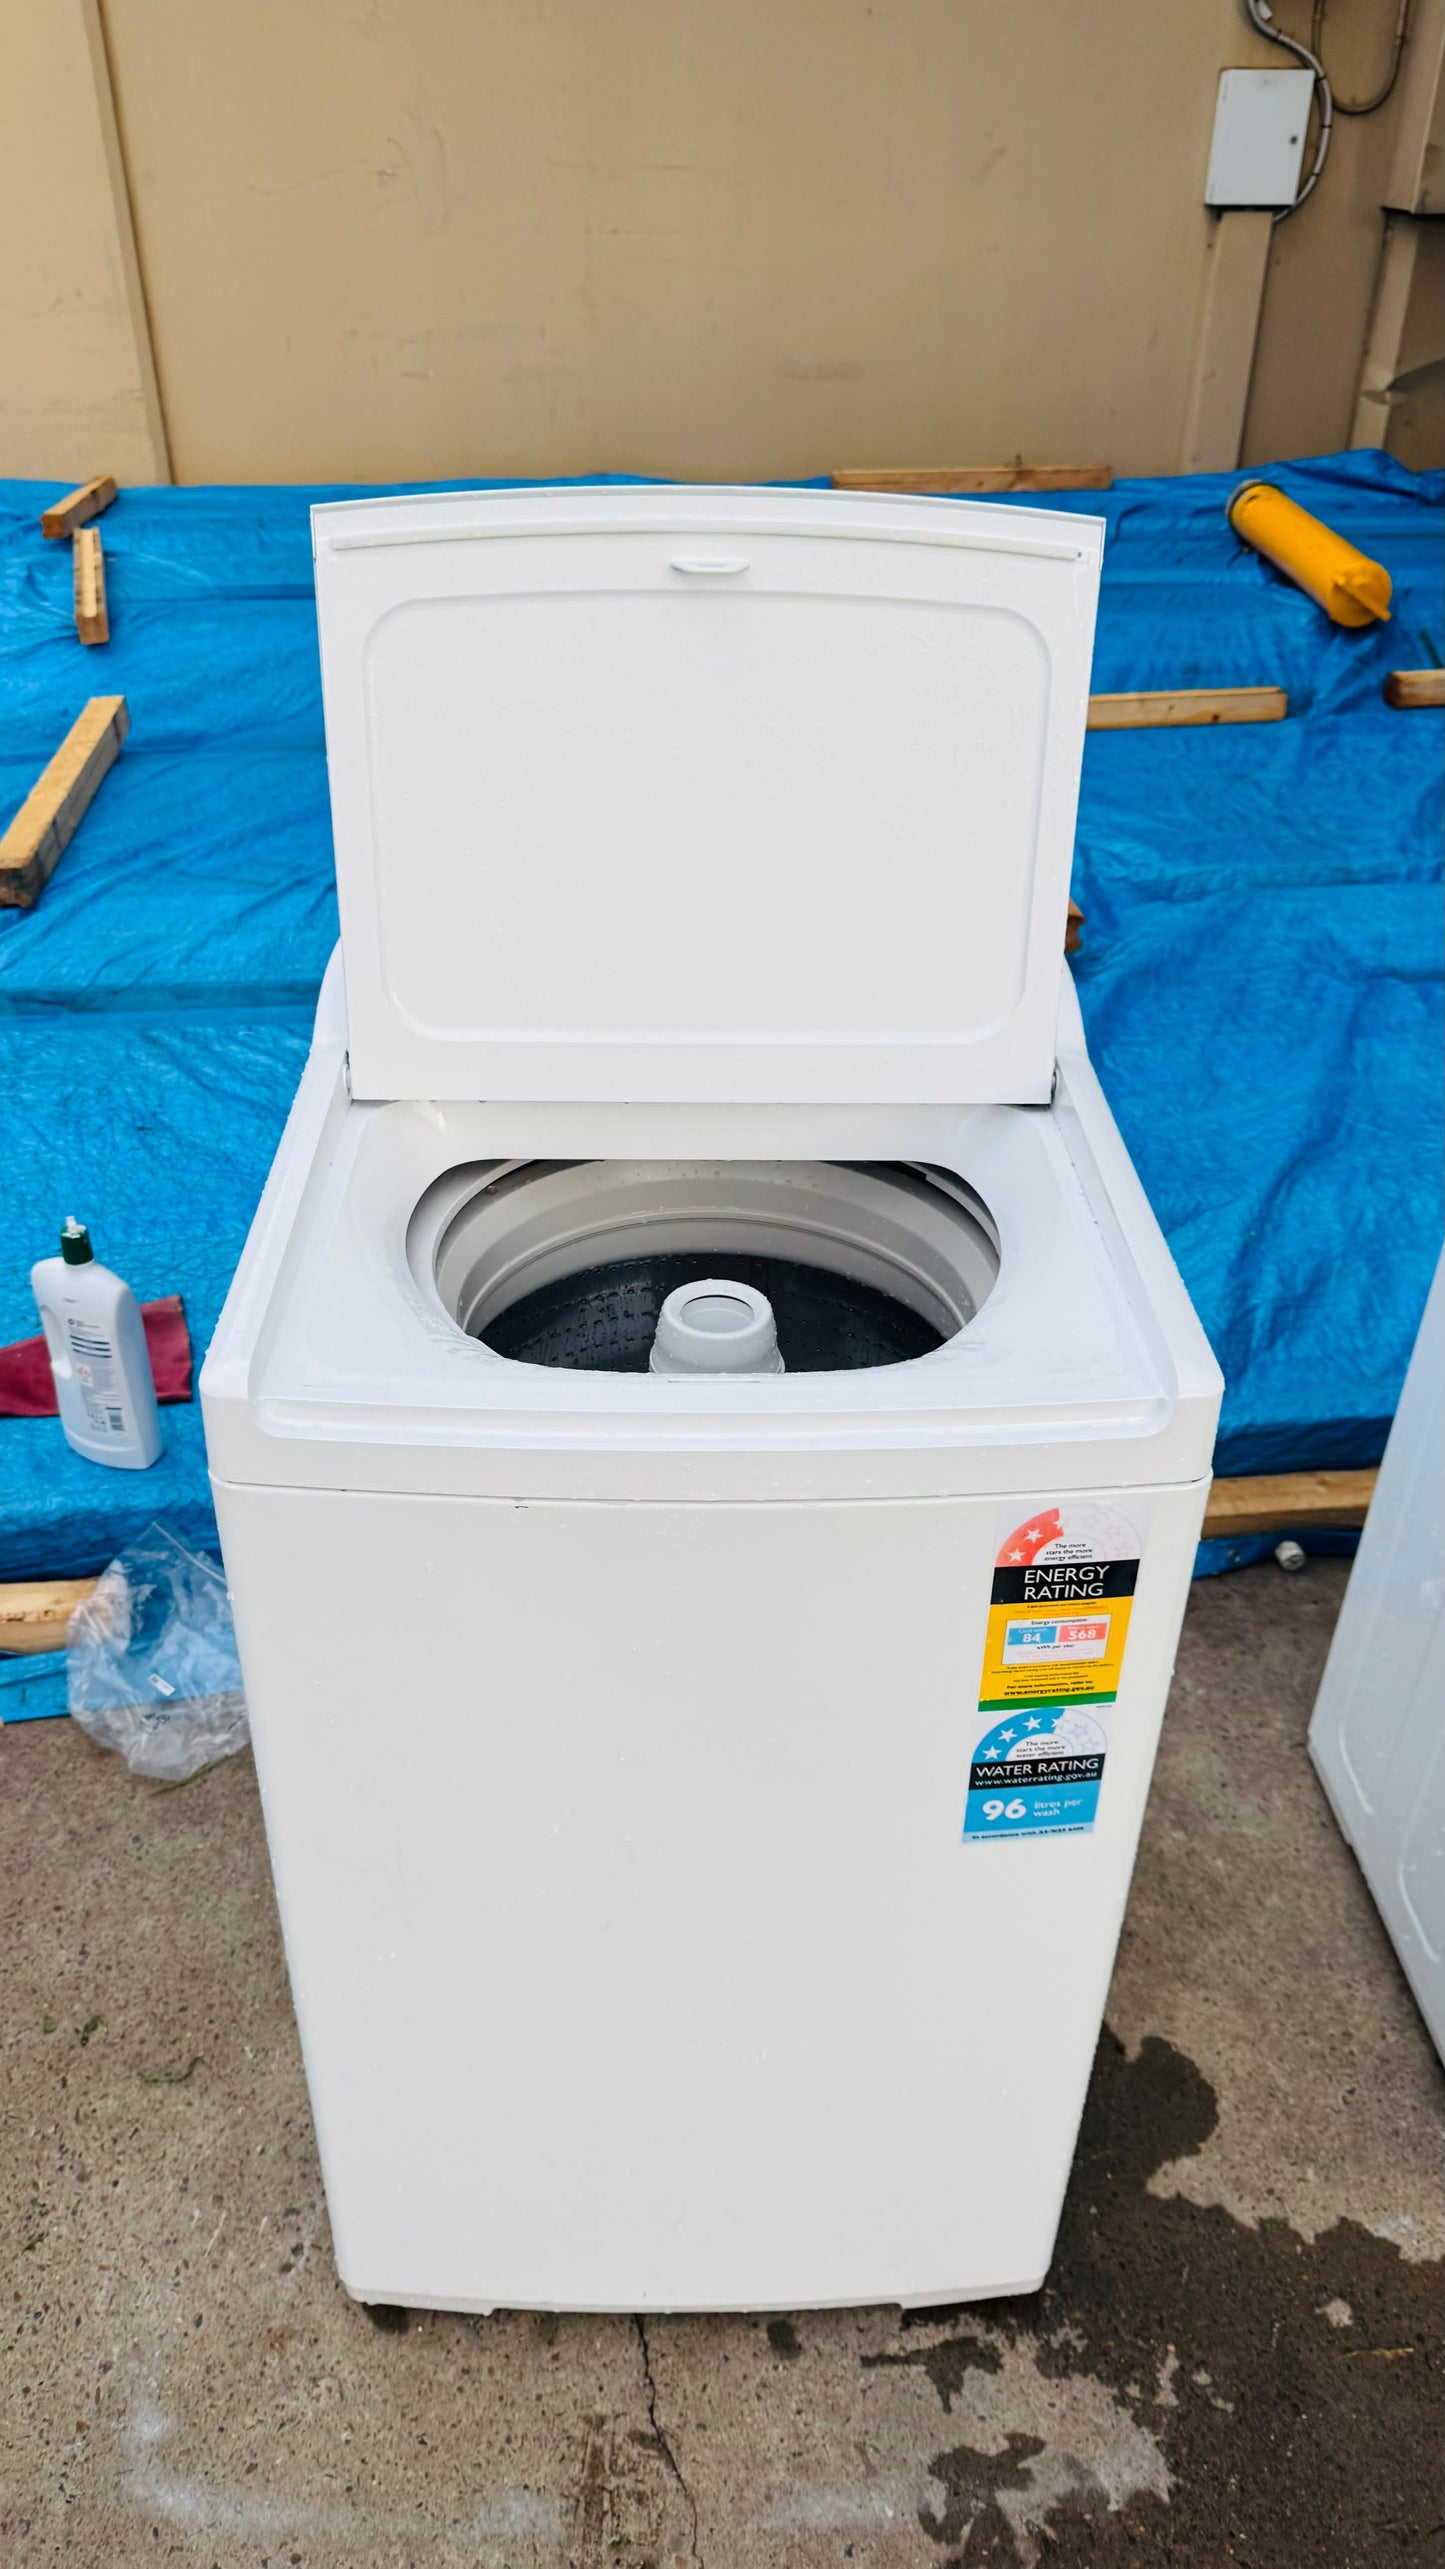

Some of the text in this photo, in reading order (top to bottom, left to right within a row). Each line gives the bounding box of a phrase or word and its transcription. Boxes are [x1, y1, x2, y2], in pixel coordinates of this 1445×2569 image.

[1024, 1565, 1110, 1584] ENERGY
[1024, 1582, 1104, 1600] RATING
[1022, 1633, 1041, 1643] 84
[1068, 1629, 1097, 1640] 568
[1004, 1686, 1095, 1697] www.energyrating.gov.au
[976, 1758, 1099, 1777] WATER RATING
[974, 1771, 1098, 1786] www.waterrating.gov.au
[982, 1798, 1027, 1821] 96
[1034, 1798, 1083, 1809] litres per
[1033, 1808, 1061, 1817] wash
